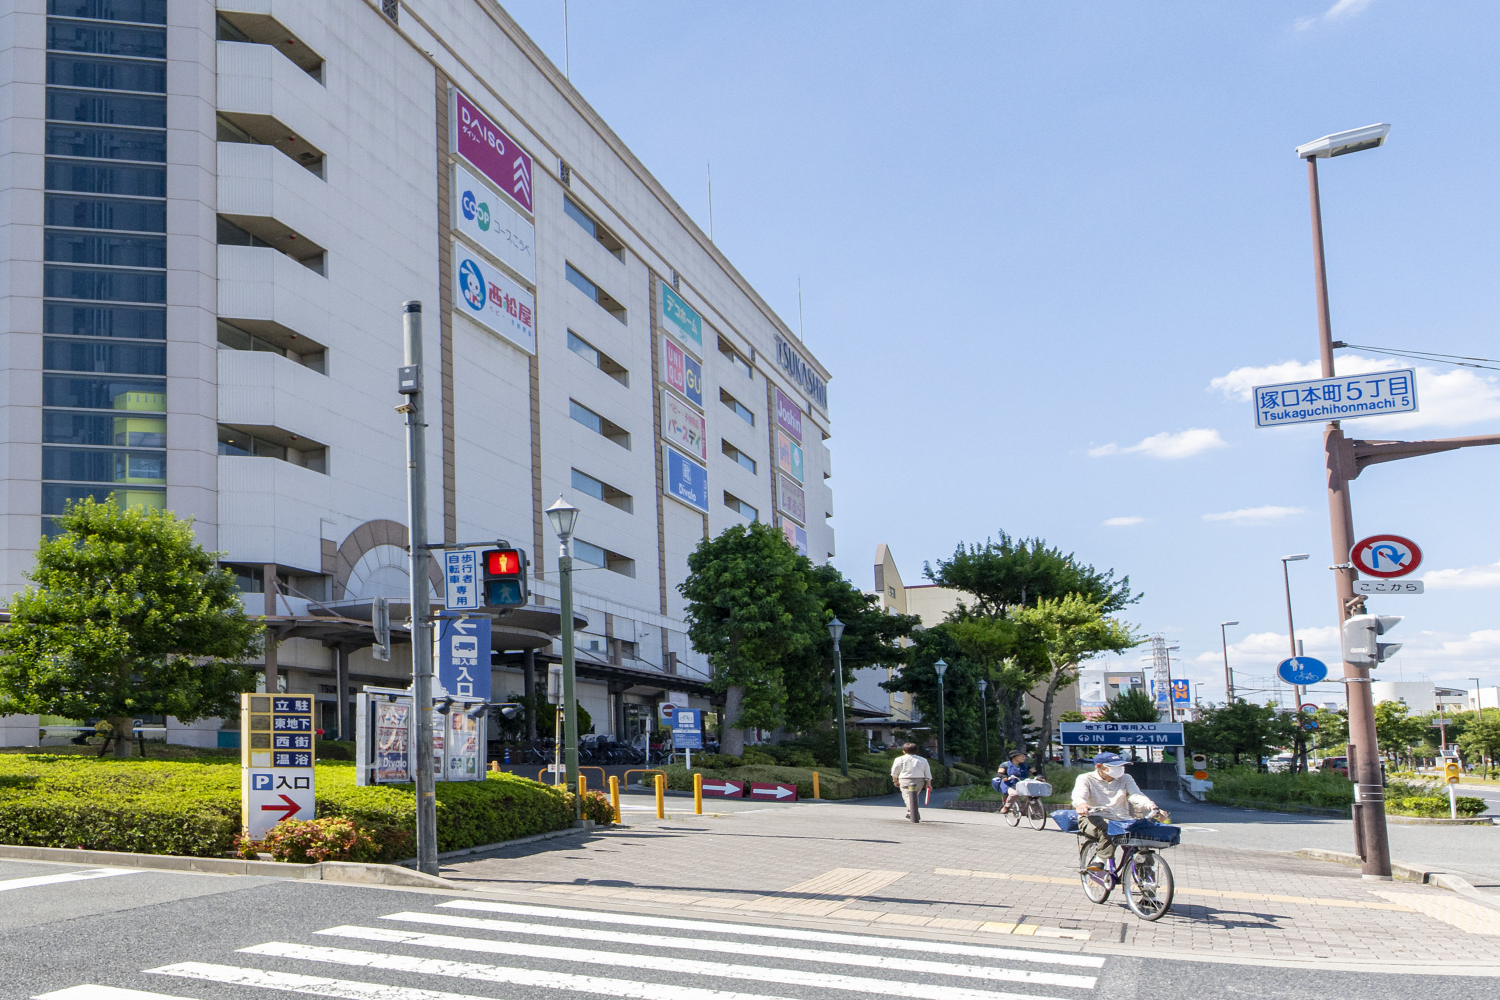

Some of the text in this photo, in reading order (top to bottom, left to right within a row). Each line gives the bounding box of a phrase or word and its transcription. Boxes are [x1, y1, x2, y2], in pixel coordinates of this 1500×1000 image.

[462, 106, 505, 155] DAISO
[488, 281, 531, 328] 西松屋
[666, 294, 698, 335] デコホーム
[668, 346, 681, 368] UNI
[686, 369, 701, 394] GU
[1260, 376, 1408, 409] 塚口本町5丁目
[1262, 396, 1410, 421] Tsukaguchihonmachi 5
[449, 555, 460, 584] 自転車
[462, 554, 473, 583] 歩行者
[456, 586, 467, 606] 専用
[1360, 583, 1417, 592] ここから
[456, 667, 474, 697] 入口
[275, 718, 310, 729] 東地下
[275, 736, 309, 748] 西街
[1092, 734, 1105, 742] IN
[1136, 734, 1168, 742] 2.1M
[275, 753, 309, 766] 温浴
[275, 775, 310, 790] 入口
